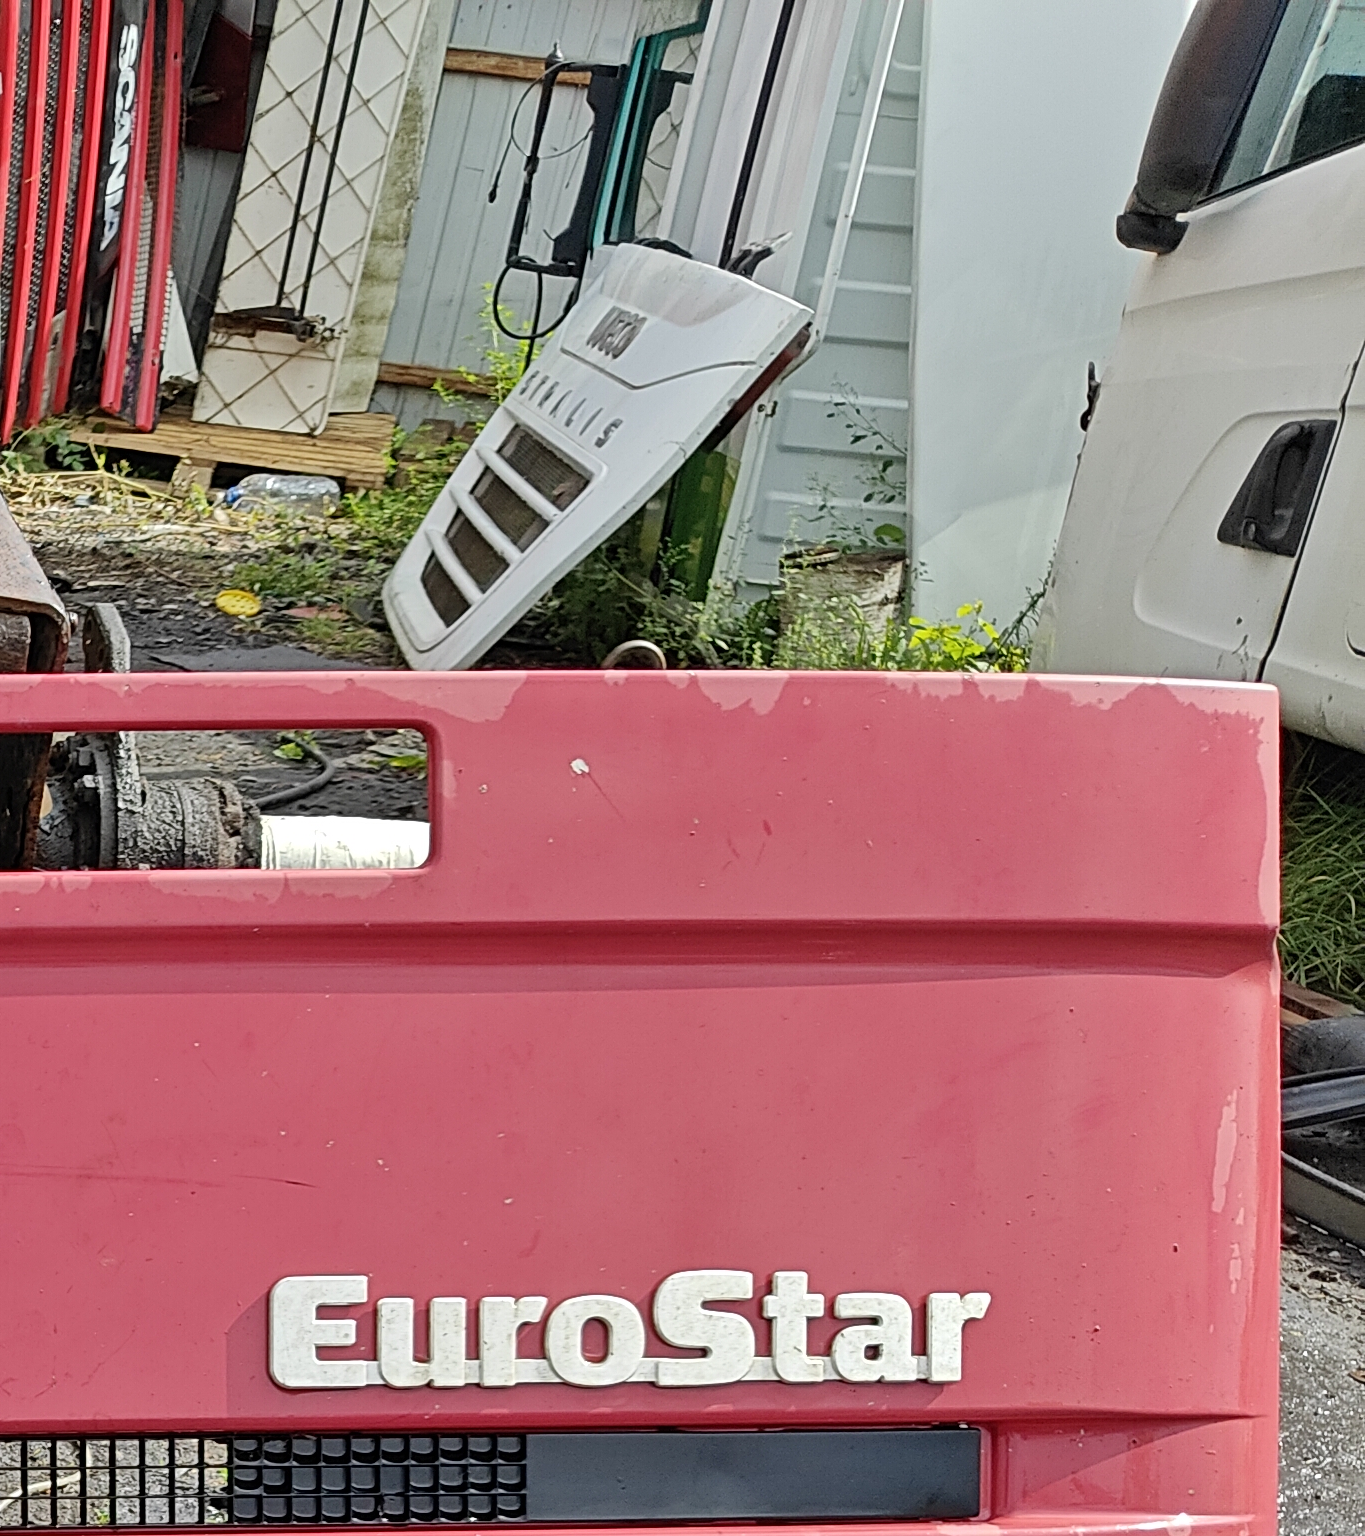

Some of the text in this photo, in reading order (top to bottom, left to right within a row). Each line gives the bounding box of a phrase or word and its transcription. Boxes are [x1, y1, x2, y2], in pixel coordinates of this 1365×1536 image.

[99, 23, 139, 251] SCANIA
[519, 370, 624, 448] STRALIS
[269, 1270, 991, 1389] EuroStar
